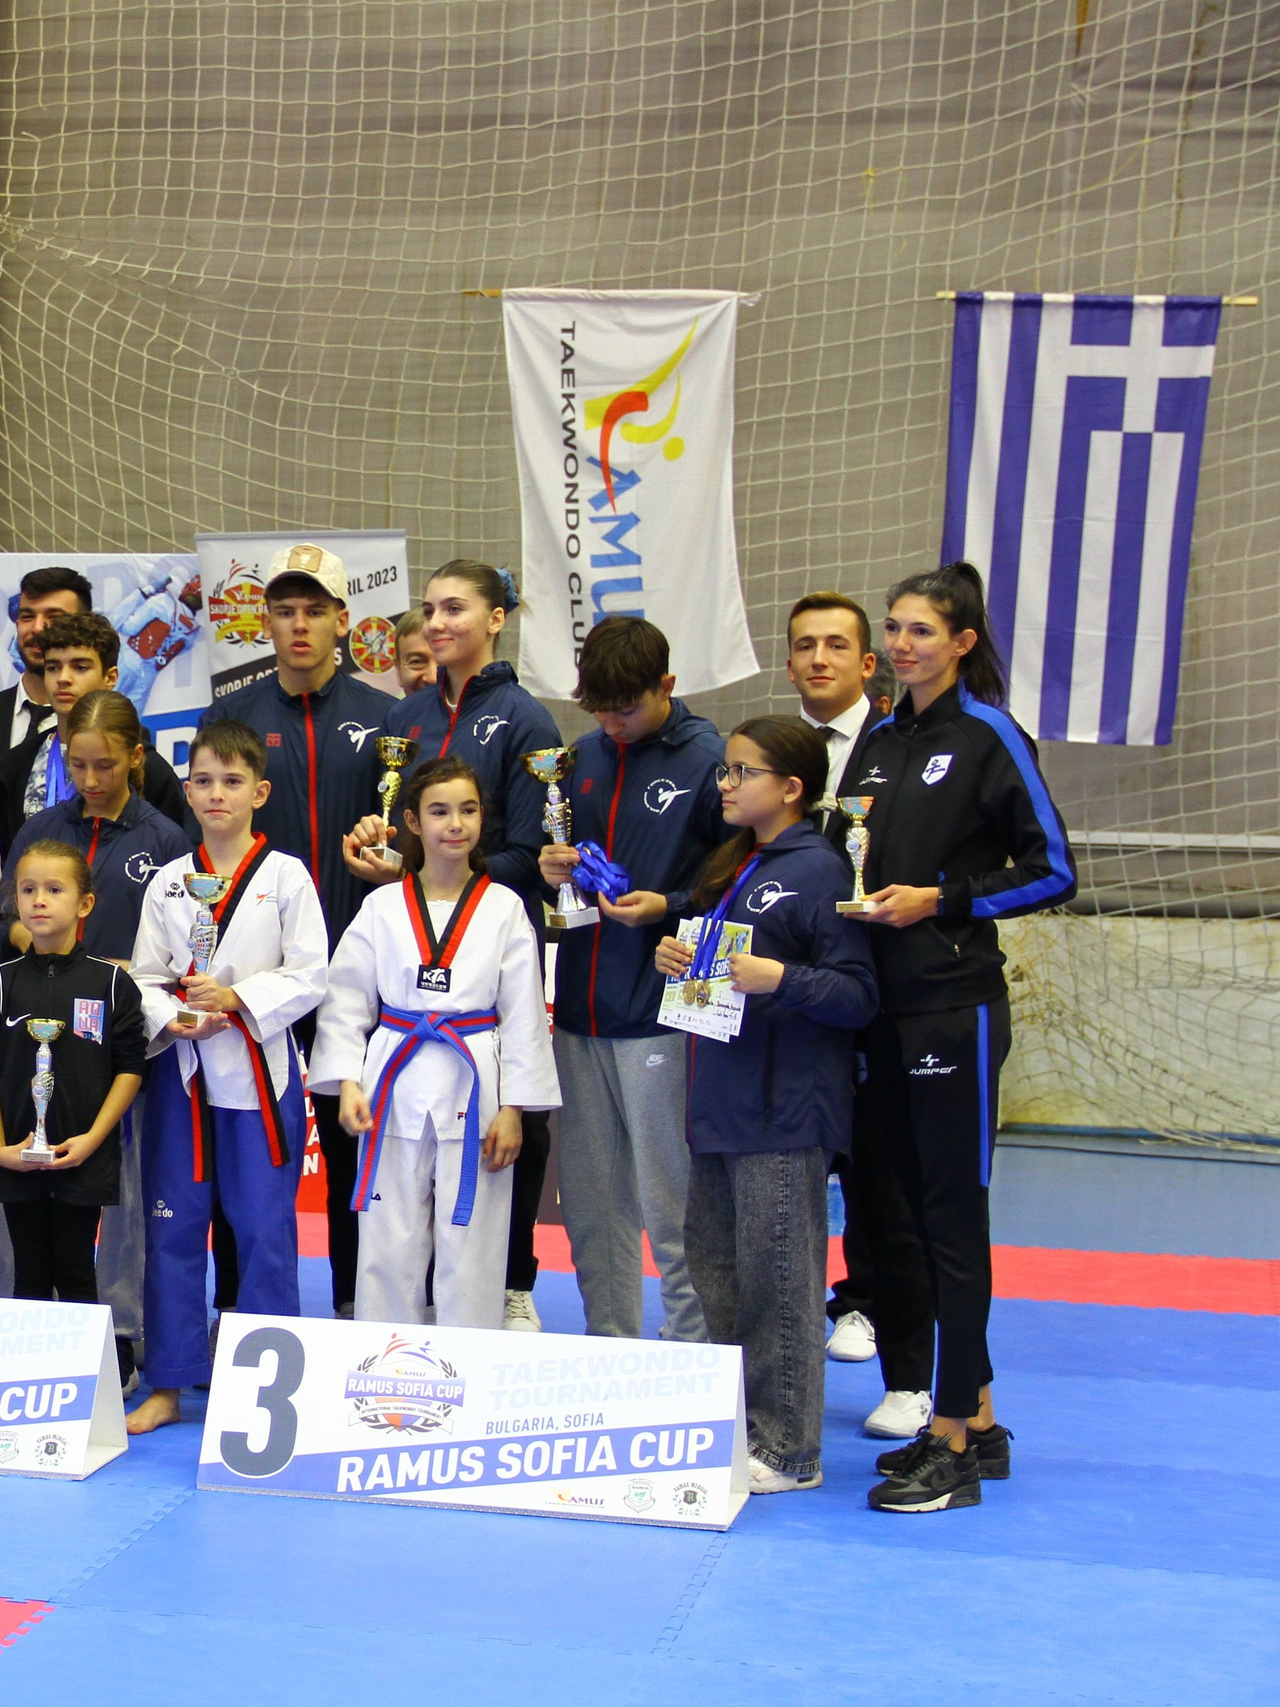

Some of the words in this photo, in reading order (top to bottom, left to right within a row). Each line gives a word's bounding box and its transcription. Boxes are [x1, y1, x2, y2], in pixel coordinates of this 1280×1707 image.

[560, 321, 581, 560] TAEKWONDO
[367, 565, 397, 590] 2023
[423, 968, 446, 983] KTA
[492, 1346, 719, 1385] TAEKWONDO
[219, 1327, 305, 1477] 3
[347, 1378, 394, 1395] RAMUS
[396, 1381, 434, 1398] SOFIA
[436, 1383, 463, 1399] CUP
[489, 1372, 719, 1410] TOURNAMENT
[485, 1416, 559, 1435] BULGARIA,
[564, 1412, 604, 1429] SOFIA
[336, 1449, 485, 1493] RAMUS
[496, 1437, 618, 1479] SOFIA
[628, 1427, 714, 1468] CUP
